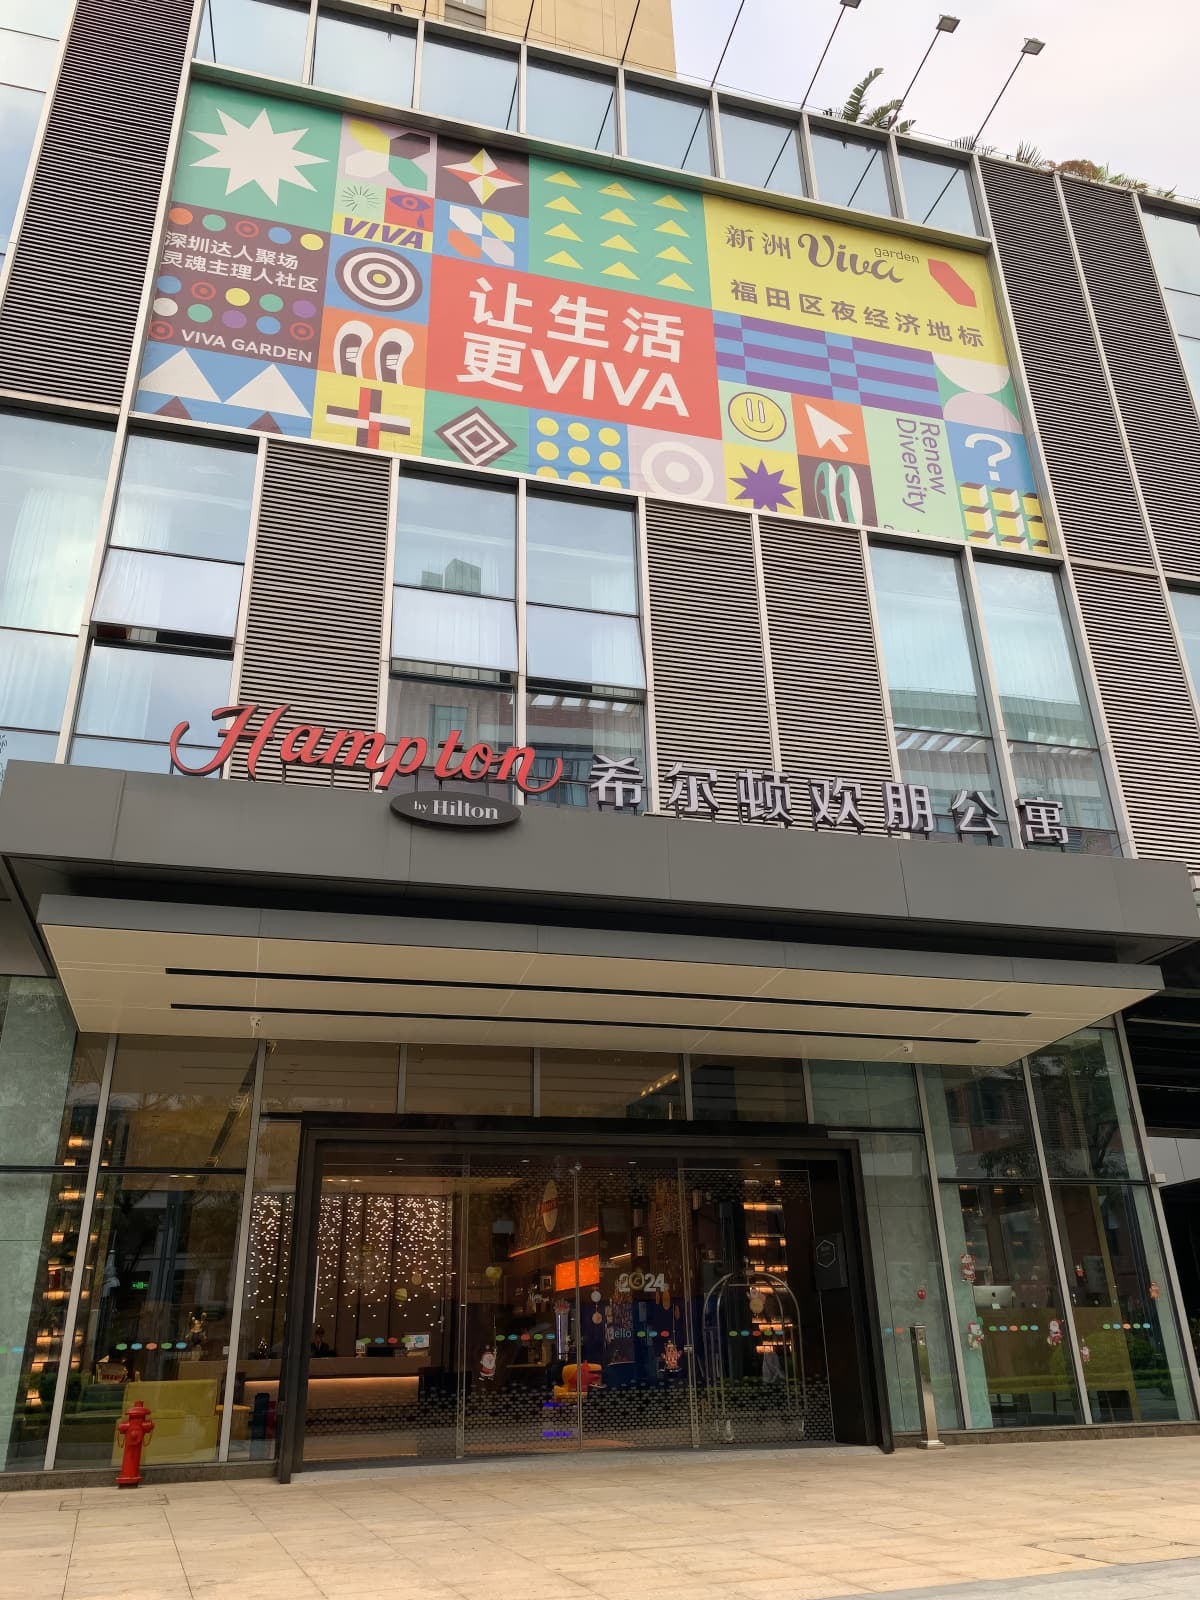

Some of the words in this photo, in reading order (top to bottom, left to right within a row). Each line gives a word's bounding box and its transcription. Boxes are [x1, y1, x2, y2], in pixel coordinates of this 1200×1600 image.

[165, 231, 298, 270] 深圳达人聚场
[344, 217, 424, 249] VIVA
[724, 225, 792, 259] 新洲
[797, 233, 904, 284] Viva
[873, 247, 920, 265] garden
[160, 250, 319, 293] 灵魂主理人社区
[469, 277, 685, 363] 让生活
[730, 279, 985, 348] 福田区夜经济地标
[181, 329, 226, 348] VIVA
[231, 339, 313, 363] GARDEN
[896, 417, 927, 514] Diversity
[919, 421, 946, 495] Renew
[169, 704, 564, 795] Hampton
[413, 800, 429, 813] by
[432, 800, 499, 819] Hilton
[590, 754, 1070, 845] 希尔顿欢朋公寓
